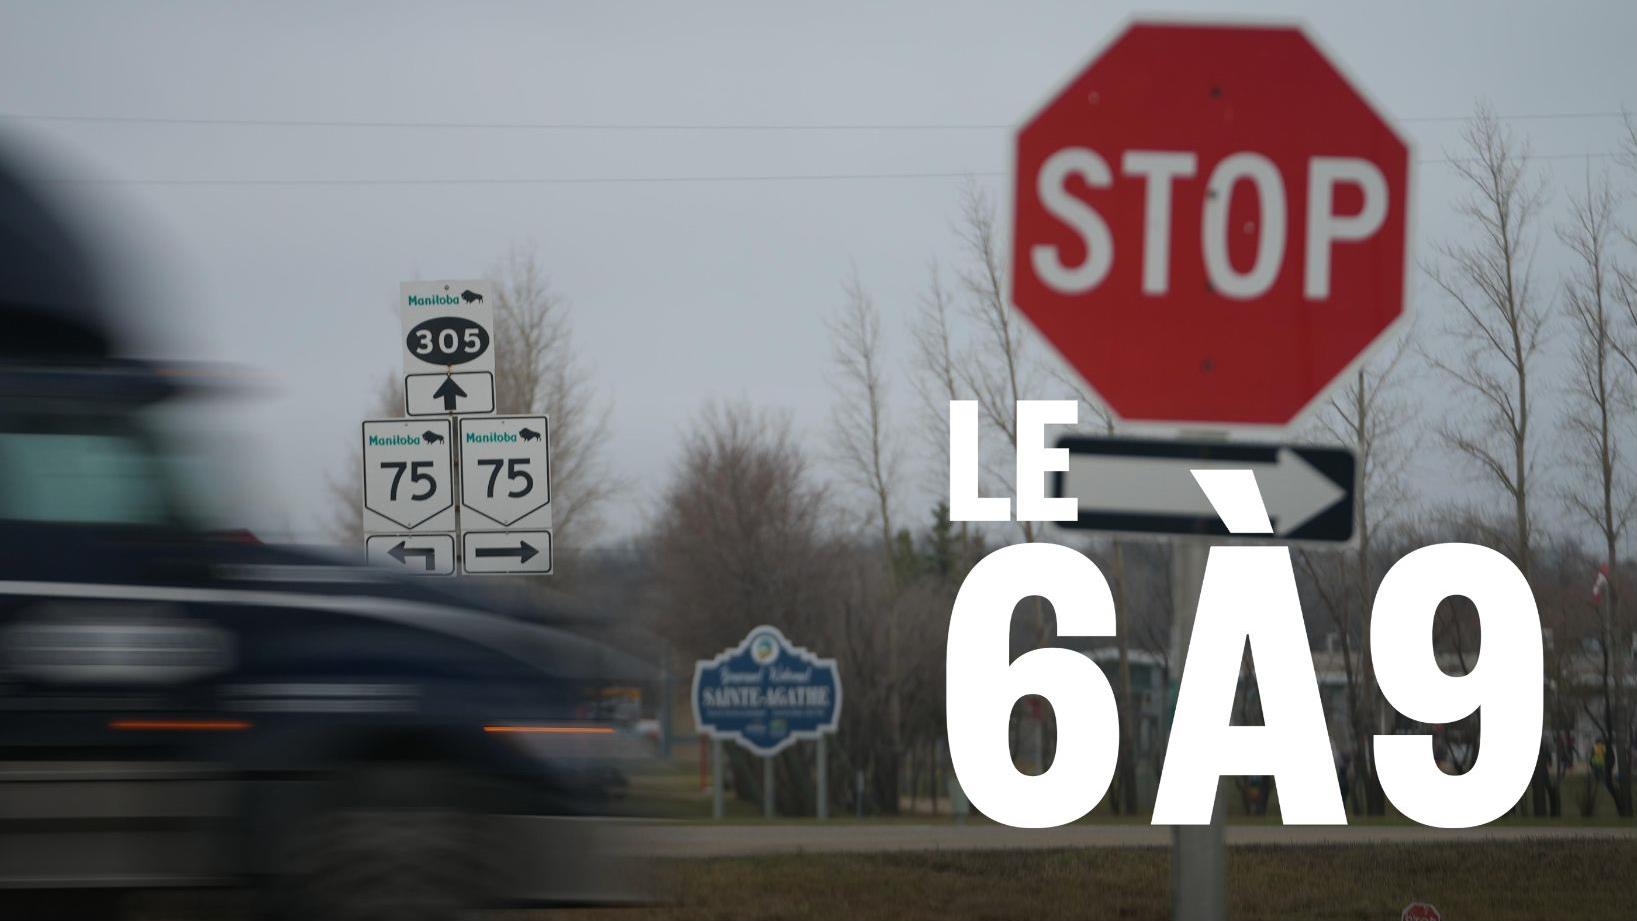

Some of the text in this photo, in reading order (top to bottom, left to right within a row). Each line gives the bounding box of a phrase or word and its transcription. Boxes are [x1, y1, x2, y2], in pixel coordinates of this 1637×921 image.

[1030, 146, 1389, 300] STOP
[408, 294, 460, 306] Manitoba
[415, 328, 481, 355] 305
[369, 434, 421, 446] Manitoba
[465, 432, 517, 444] Manitoba
[380, 460, 437, 501] 75
[477, 457, 534, 498] 75
[702, 685, 830, 707] SAINTE-AGATHE
